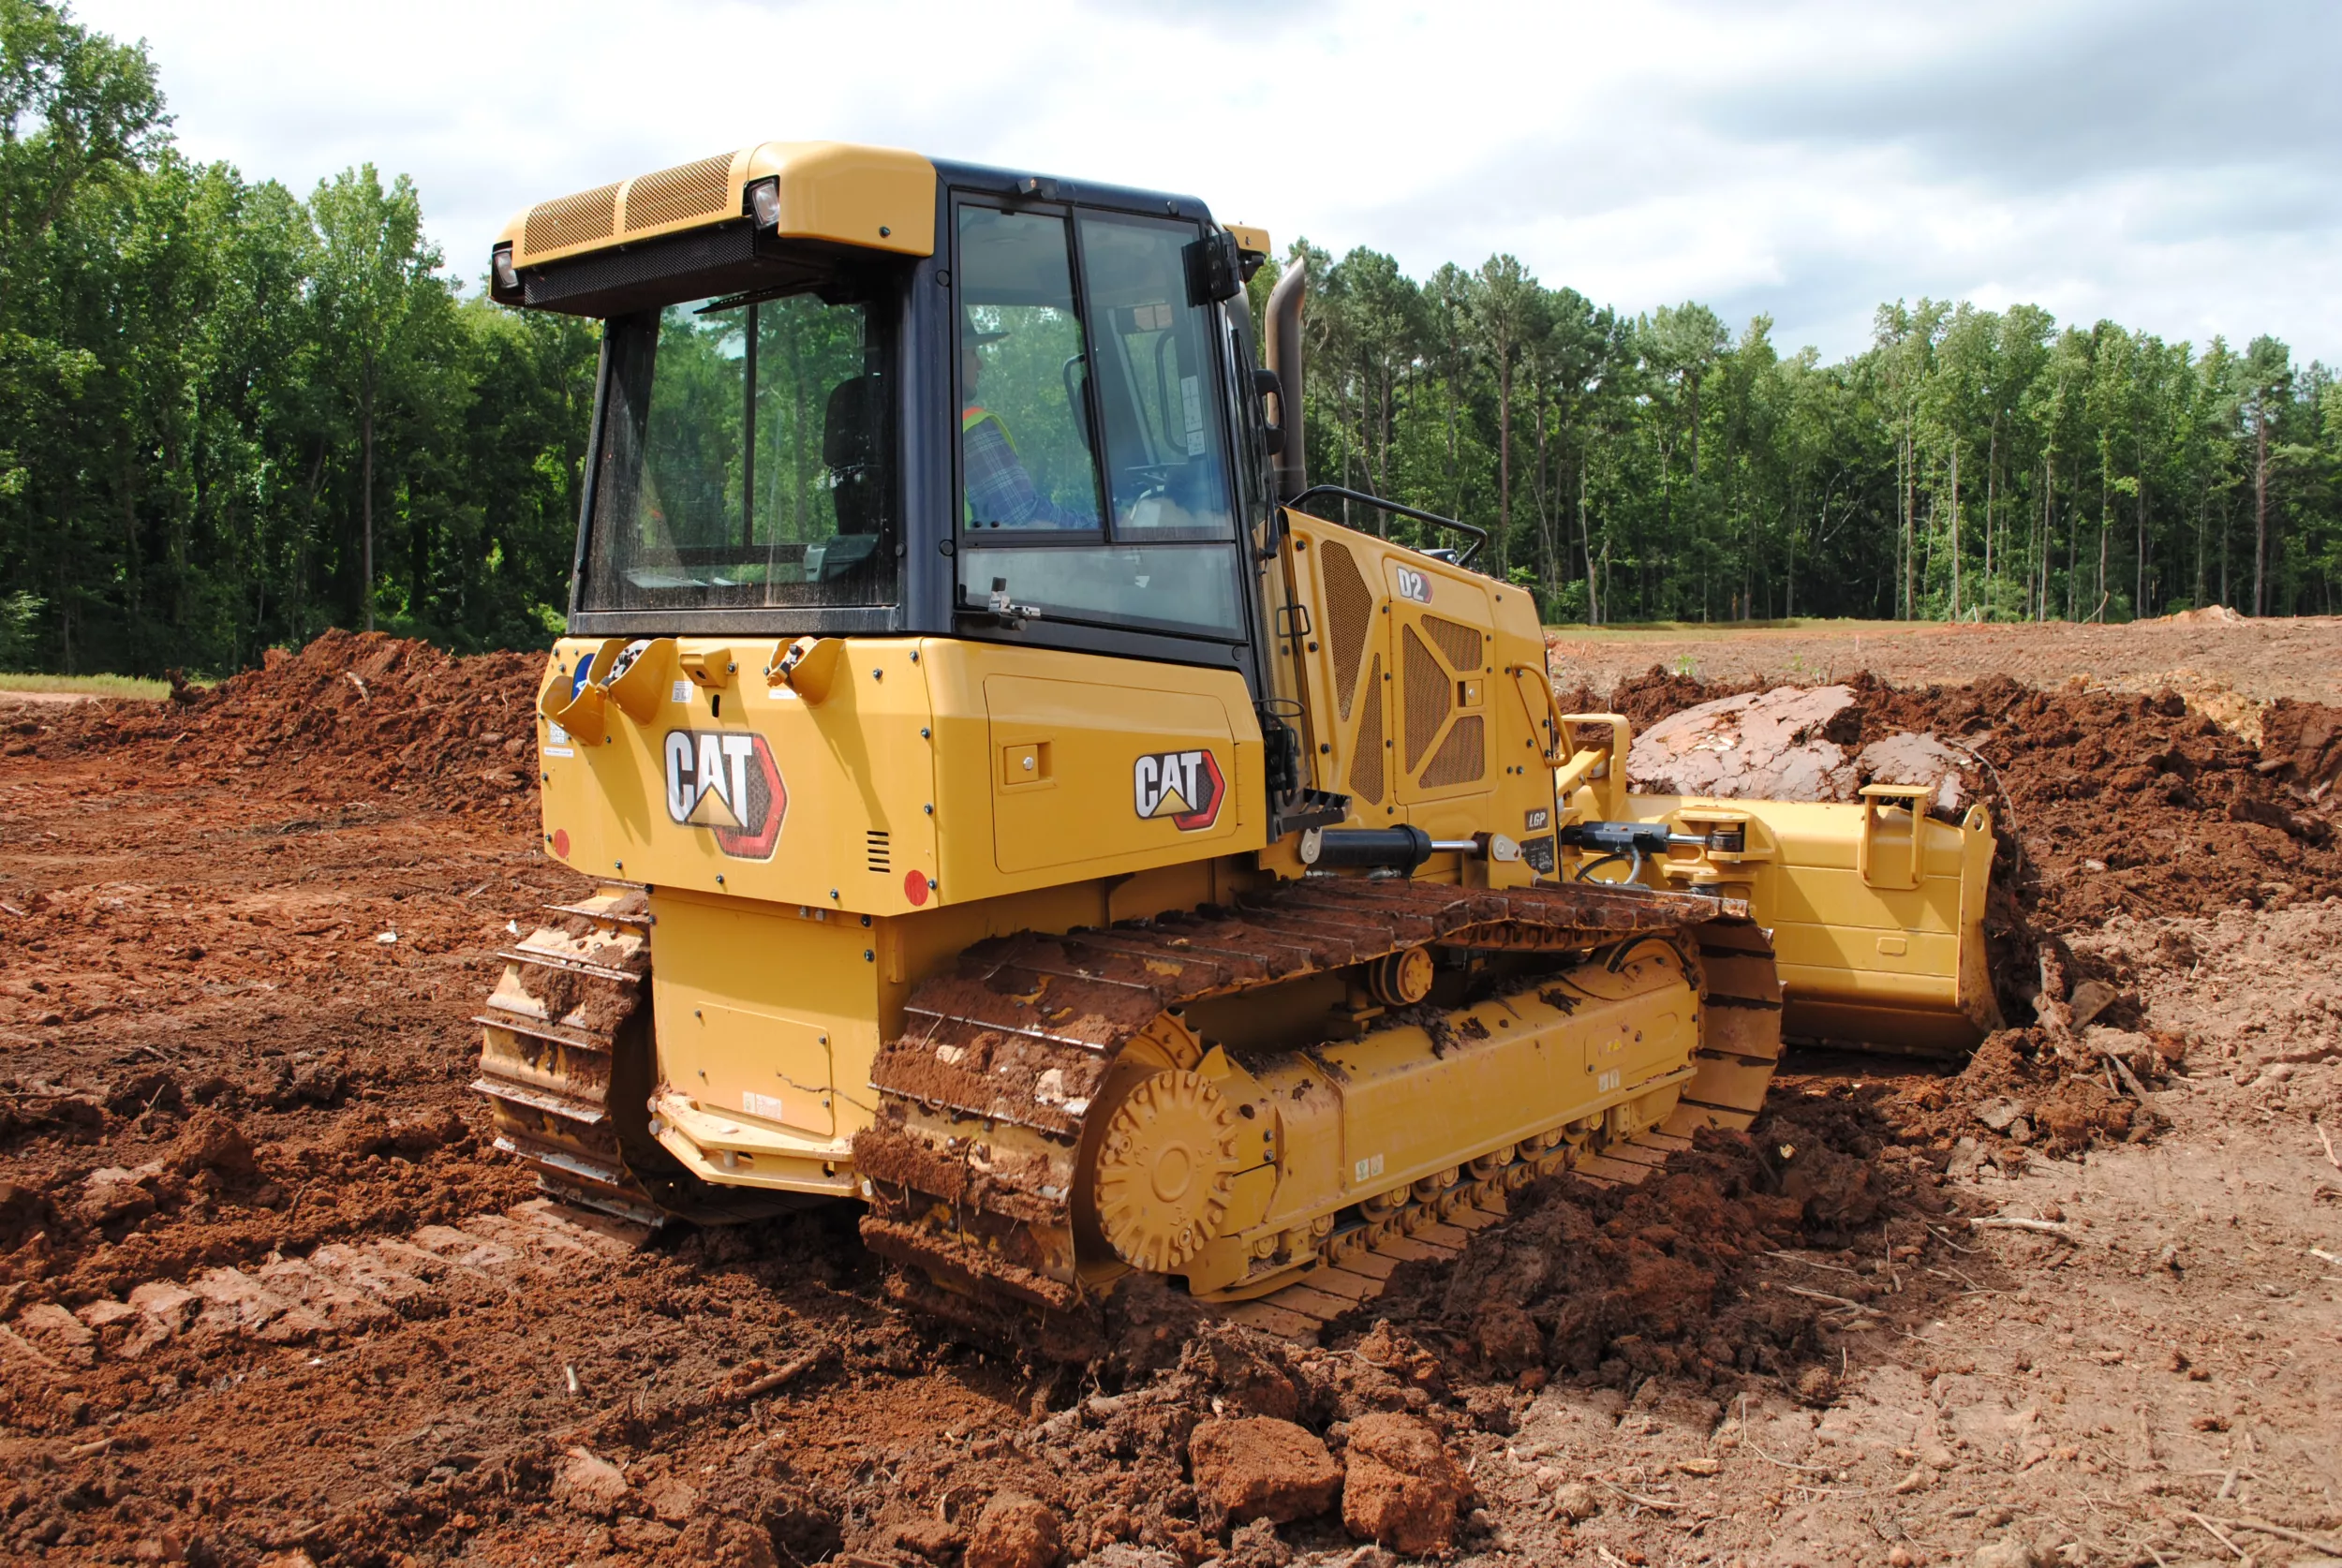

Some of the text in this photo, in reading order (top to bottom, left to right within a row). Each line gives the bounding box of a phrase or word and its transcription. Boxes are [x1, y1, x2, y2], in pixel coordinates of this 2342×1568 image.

[1397, 568, 1424, 602] D2
[665, 732, 752, 828] CAT
[1134, 751, 1202, 818] CAT
[1528, 811, 1547, 828] LGP
